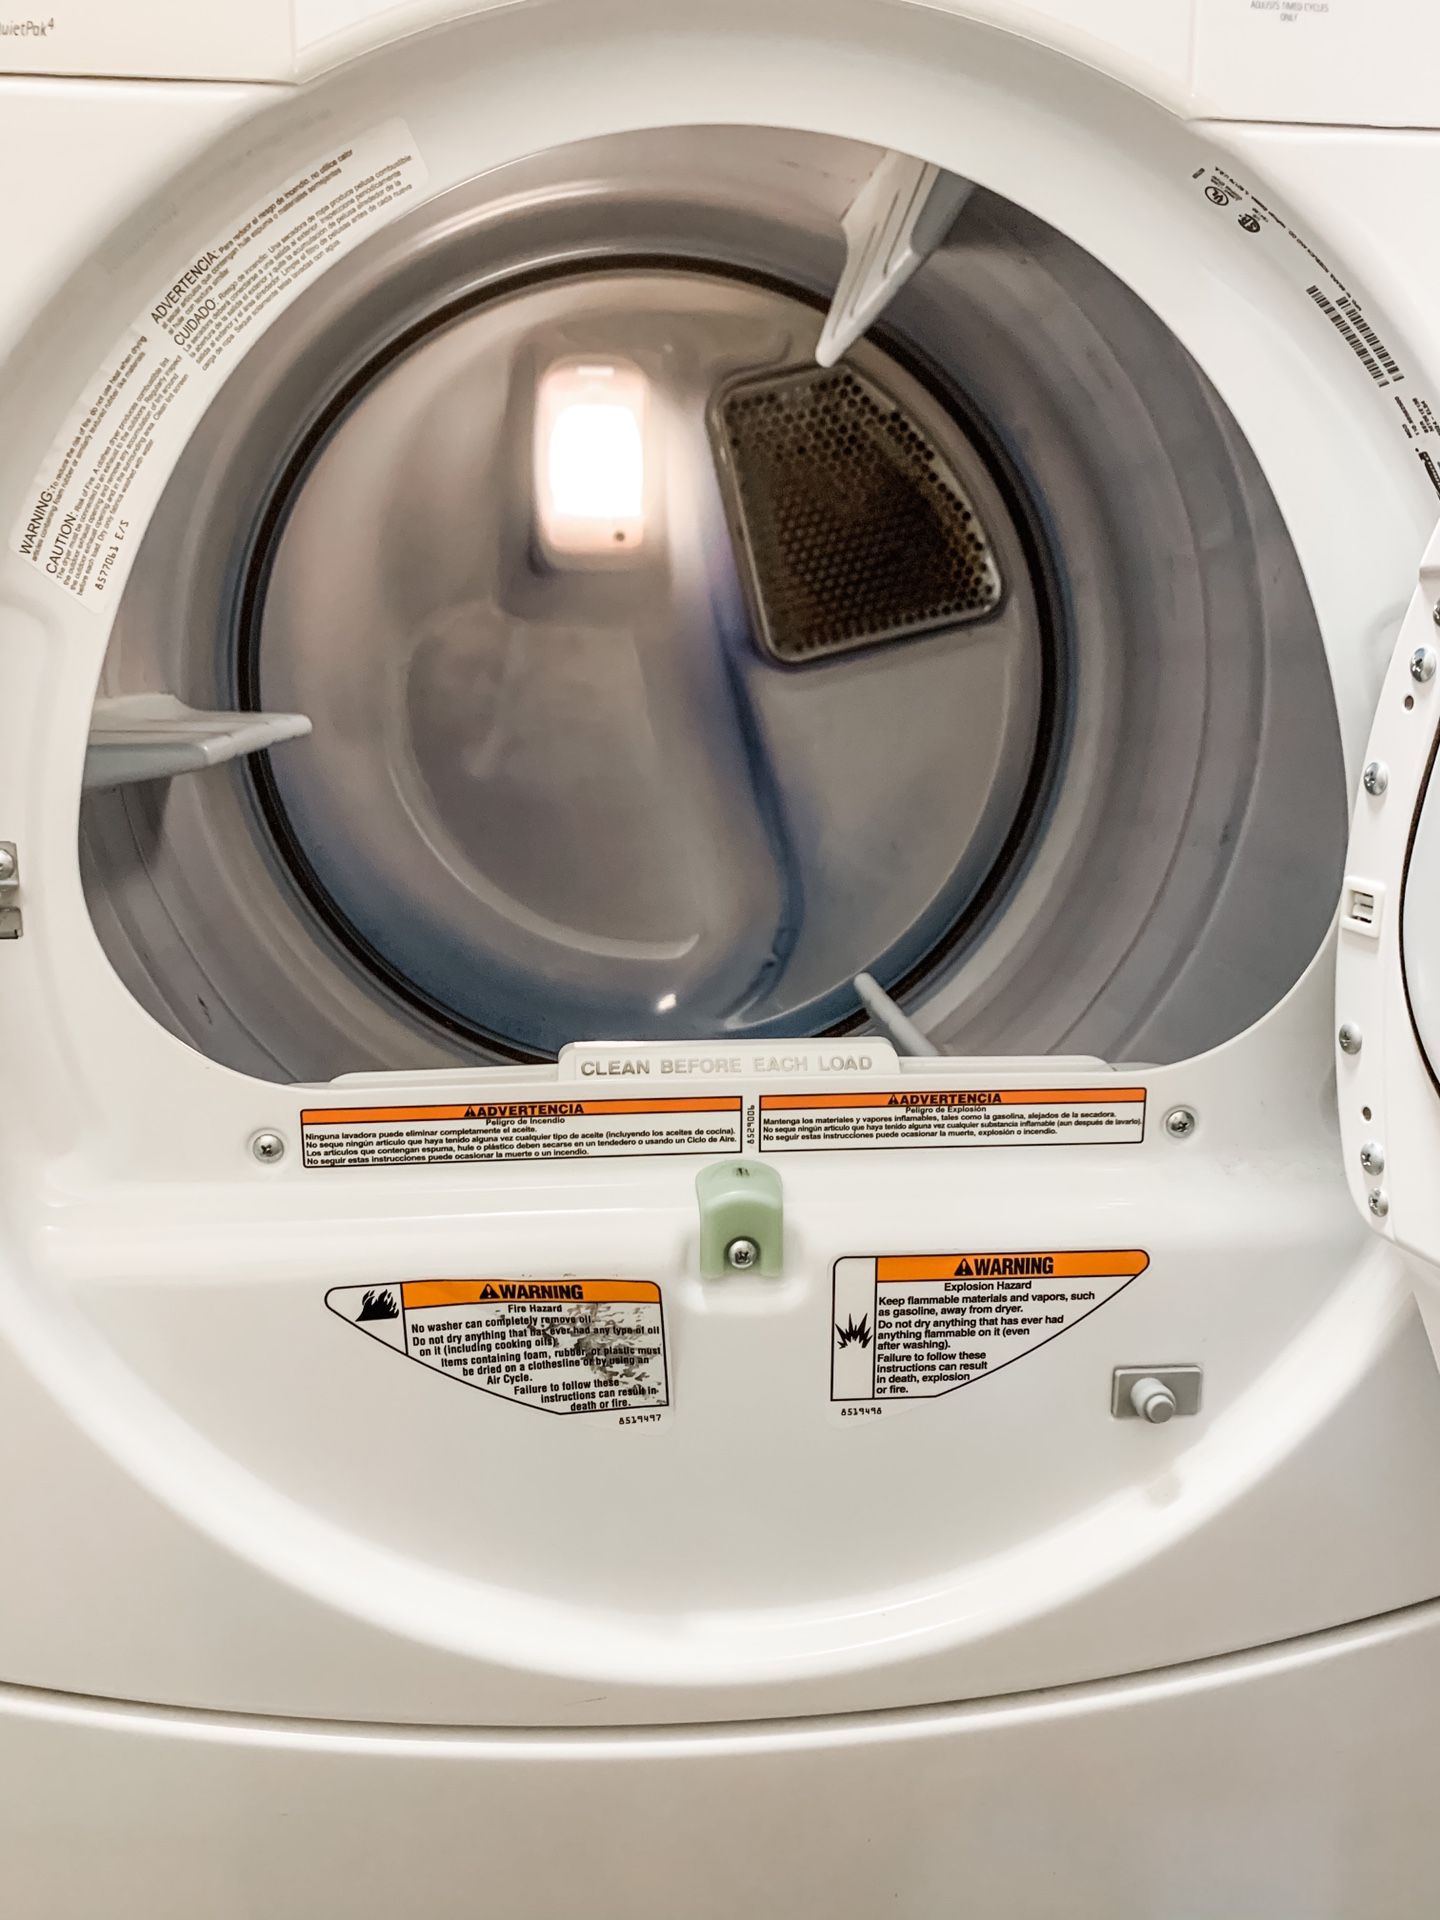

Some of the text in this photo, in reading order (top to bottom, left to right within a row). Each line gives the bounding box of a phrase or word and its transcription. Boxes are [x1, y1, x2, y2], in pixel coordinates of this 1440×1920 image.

[19, 488, 55, 555] WARNING:
[45, 512, 79, 574] CAUTION:
[95, 519, 130, 590] 8577061 E/S
[580, 1055, 873, 1076] CLEAN BEFORE EACH LOAD
[900, 1093, 1002, 1105] ADVERTENCIA
[477, 1104, 584, 1116] ADVERTENCIA
[906, 1106, 933, 1114] Peligro
[948, 1106, 986, 1114] Explosión
[486, 1118, 515, 1127] Peligro
[747, 1105, 755, 1144] 8529006
[764, 1117, 800, 1126] Mantenga
[802, 1116, 813, 1124] los
[894, 1114, 939, 1123] inflamables,
[992, 1113, 1025, 1121] gasolina,
[1028, 1112, 1058, 1121] alejados
[776, 1133, 799, 1142] seguir
[876, 1131, 898, 1140] puede
[948, 1129, 976, 1138] muerte,
[978, 1129, 1014, 1137] explosión
[974, 1257, 1054, 1275] WARNING
[499, 1284, 583, 1299] WARNING
[944, 1281, 1031, 1293] Explosion Hazard
[879, 1291, 1094, 1307] Keep flammable materials and vapors, such
[508, 1304, 562, 1313] Fire Hazard
[893, 1306, 938, 1318] gasoline,
[941, 1308, 966, 1317] away
[969, 1305, 992, 1314] from
[995, 1304, 1022, 1315] dryer.
[411, 1323, 424, 1334] No
[428, 1320, 462, 1332] washer
[465, 1320, 482, 1329] can
[485, 1315, 538, 1330] completely
[540, 1316, 576, 1324] remove
[878, 1319, 892, 1328] Do
[895, 1319, 912, 1328] not
[914, 1318, 930, 1329] dry
[933, 1318, 976, 1329] anything
[979, 1317, 998, 1326] that
[1001, 1316, 1018, 1325] has
[1045, 1315, 1063, 1324] had
[412, 1336, 426, 1346] Do
[428, 1334, 444, 1345] not
[446, 1333, 462, 1345] dry
[465, 1328, 506, 1344] anything
[508, 1328, 528, 1337] that
[550, 1327, 571, 1335] ever
[573, 1324, 590, 1334] had
[593, 1326, 610, 1336] any
[612, 1324, 632, 1336] type
[634, 1324, 644, 1334] of
[648, 1324, 660, 1334] oil
[878, 1330, 922, 1342] anything
[924, 1328, 976, 1338] flammable
[994, 1327, 1000, 1336] it
[1002, 1326, 1029, 1337] (even
[420, 1348, 432, 1356] on
[434, 1345, 441, 1355] it
[444, 1340, 492, 1356] (including
[495, 1338, 532, 1351] cooking
[878, 1340, 950, 1351] after washing).
[470, 1352, 521, 1367] containing
[524, 1349, 552, 1361] foam,
[591, 1347, 601, 1355] or
[604, 1345, 635, 1356] plastic
[637, 1345, 661, 1354] must
[878, 1351, 986, 1362] Failure to follow these
[462, 1366, 474, 1376] be
[477, 1364, 502, 1375] dried
[504, 1364, 517, 1372] on
[528, 1357, 580, 1370] clothesline
[596, 1355, 607, 1367] by
[638, 1356, 650, 1364] an
[877, 1363, 936, 1373] instructions
[960, 1361, 987, 1370] result
[486, 1372, 533, 1385] Air Cycle.
[877, 1372, 970, 1384] in death, explosion
[514, 1377, 620, 1395] Failure to follow these
[890, 1384, 908, 1393] fire.
[540, 1390, 596, 1403] instructions
[598, 1390, 616, 1398] can
[570, 1400, 596, 1410] death
[612, 1397, 632, 1407] fire.
[841, 1408, 882, 1416] 8519498
[619, 1414, 661, 1425] 8519497
